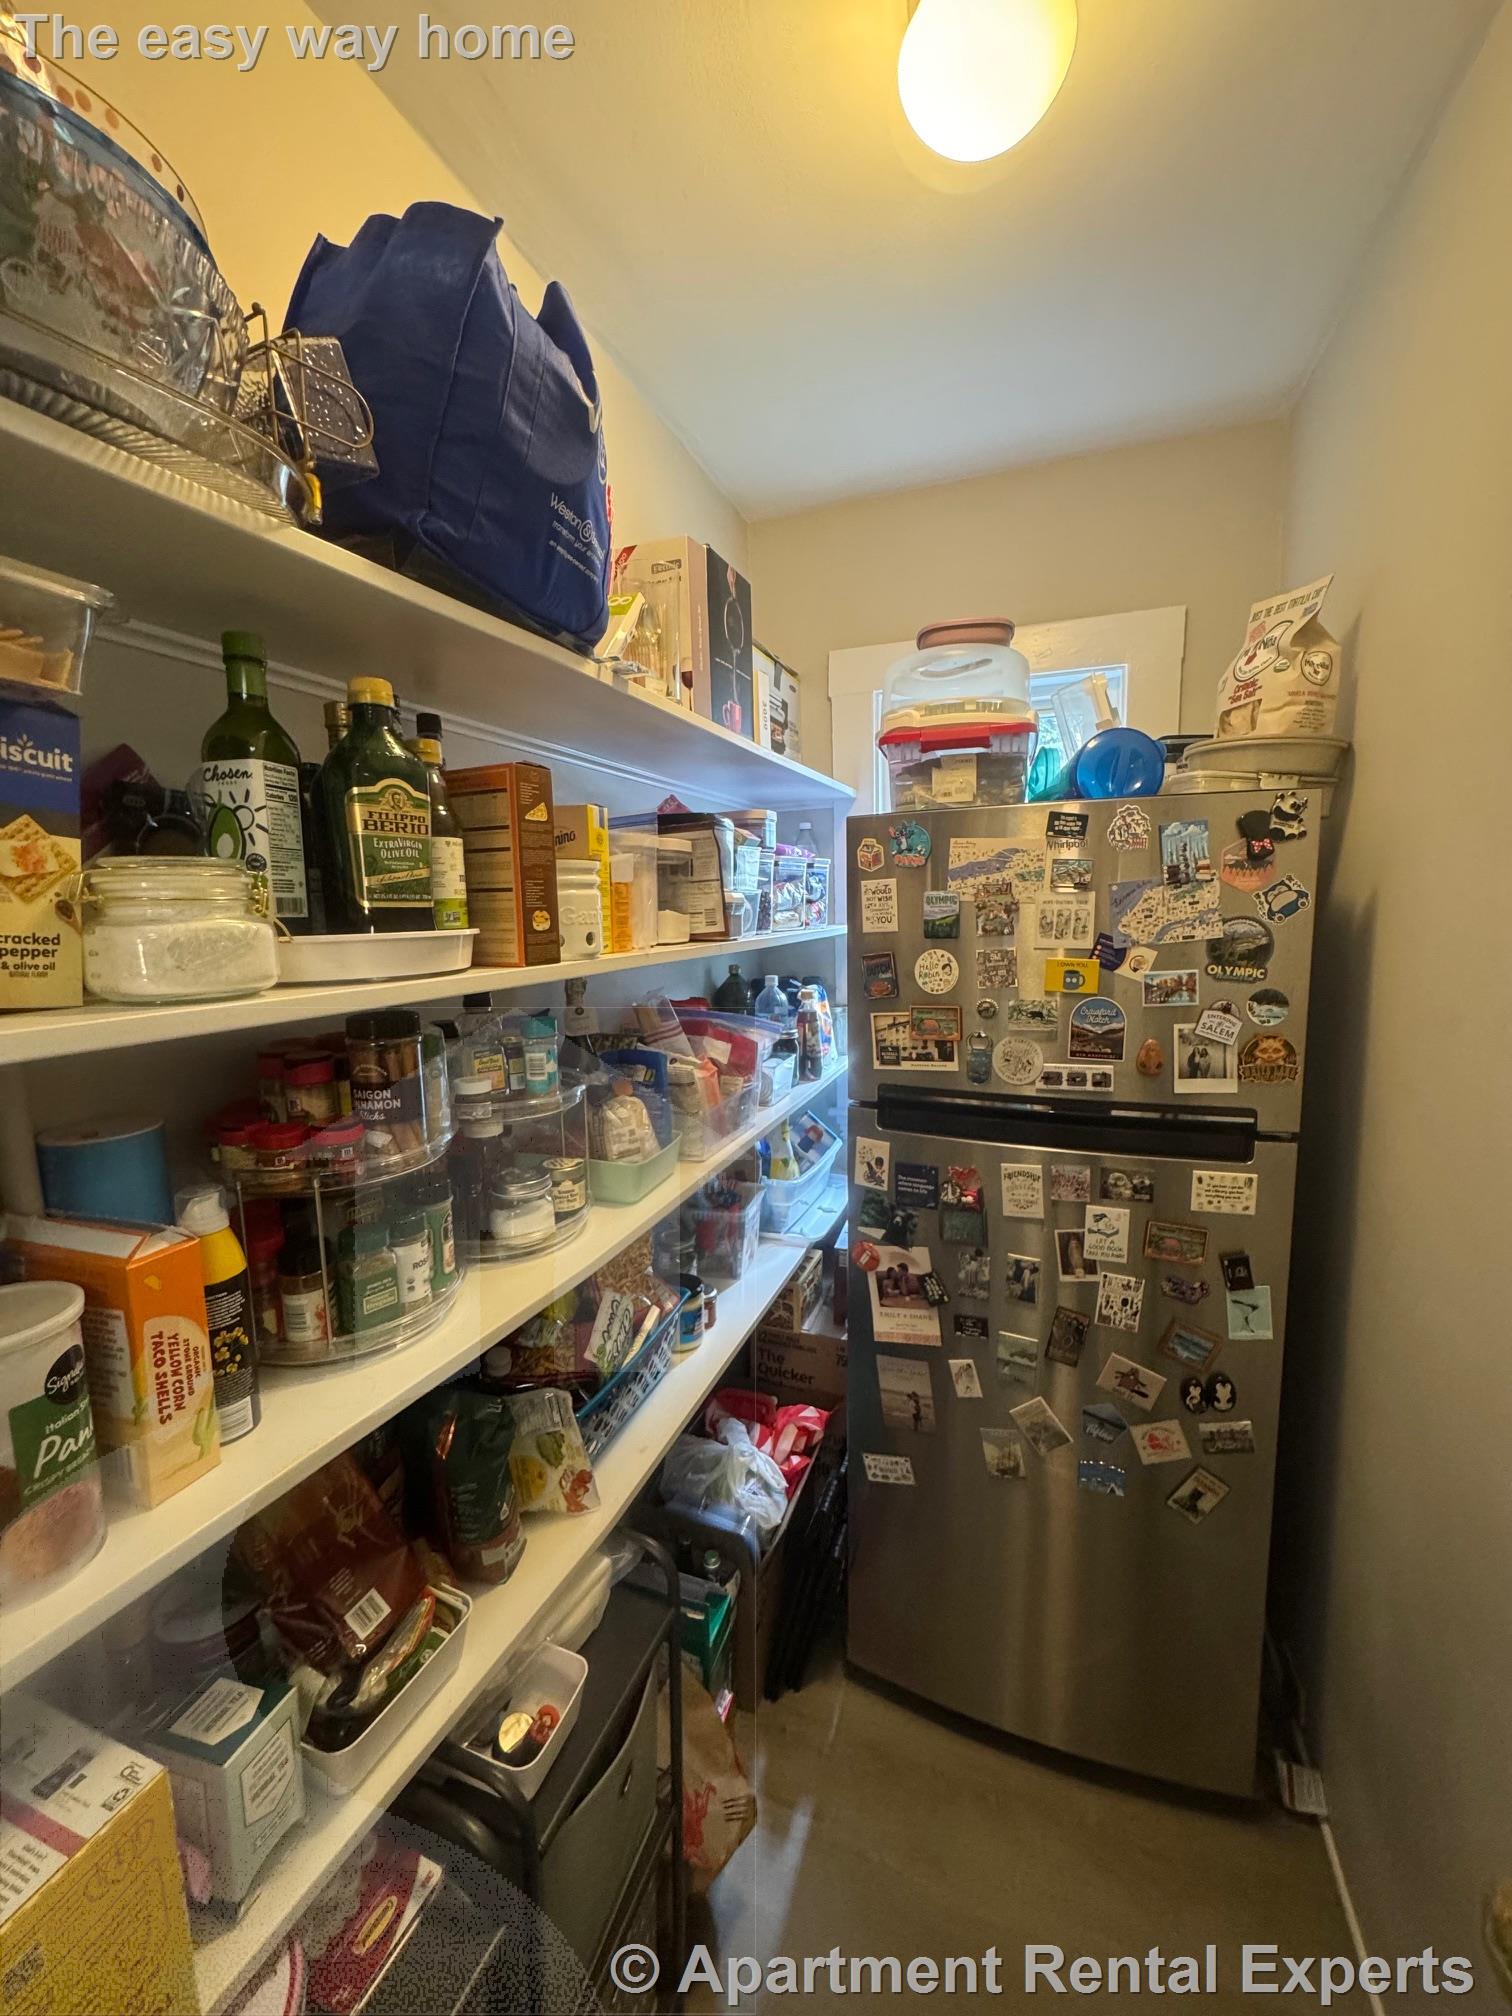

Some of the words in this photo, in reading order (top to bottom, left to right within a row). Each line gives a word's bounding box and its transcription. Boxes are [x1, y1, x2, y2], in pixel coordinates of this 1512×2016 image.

[203, 764, 253, 782] Chosen
[367, 810, 426, 823] FILIPPO
[363, 818, 429, 835] BERIO
[0, 947, 58, 960] pepper
[1, 961, 10, 970] &
[13, 961, 40, 971] olive
[42, 961, 56, 971] oil
[919, 961, 939, 971] Hello
[1206, 964, 1266, 979] OLYMPIC
[918, 970, 941, 980] Robin
[1207, 1013, 1239, 1028] ENTERING
[1200, 1022, 1236, 1040] SALEM
[353, 1089, 392, 1100] SAIGON
[1003, 1169, 1042, 1181] FRIENDSHIP
[151, 1330, 167, 1368] TACO
[167, 1333, 181, 1377] YELLOW
[182, 1338, 191, 1363] STONE
[760, 1347, 785, 1364] The
[192, 1346, 201, 1378] ORGANIC
[185, 1364, 195, 1396] GROUND
[758, 1361, 816, 1385] Quicker
[154, 1371, 173, 1425] SHELLS
[172, 1378, 186, 1411] CORN
[45, 1407, 80, 1435] Italian
